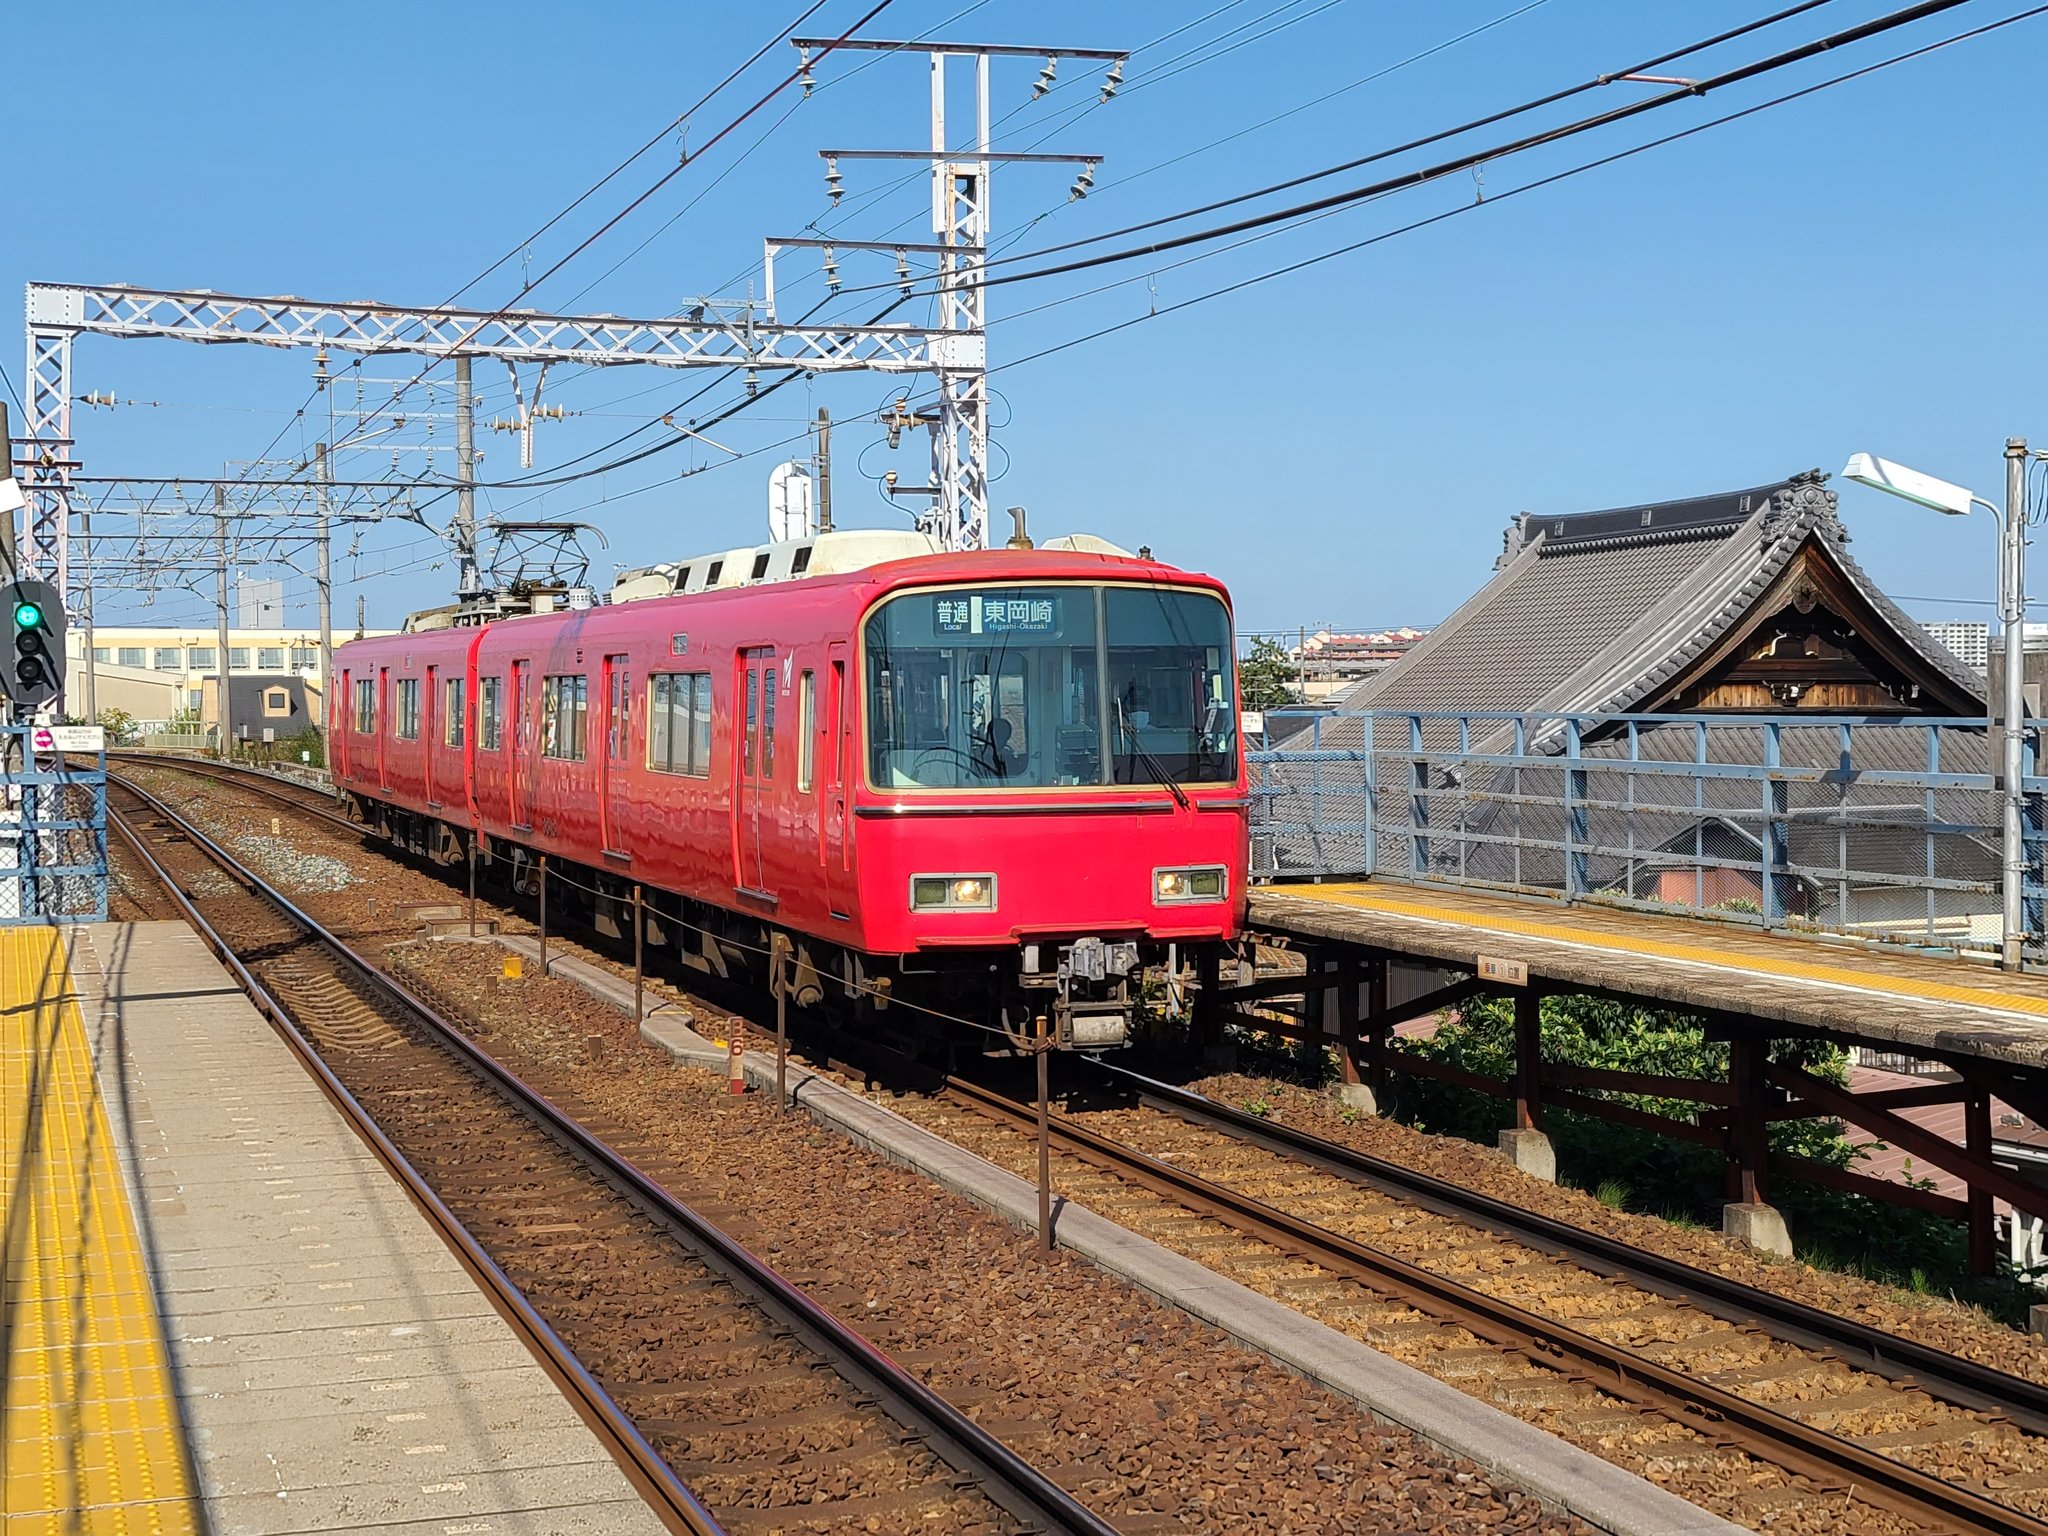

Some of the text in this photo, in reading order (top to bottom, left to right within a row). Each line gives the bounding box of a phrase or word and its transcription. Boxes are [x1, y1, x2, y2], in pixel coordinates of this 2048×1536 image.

[937, 601, 968, 623] 普通
[984, 600, 1052, 623] 東岡崎
[989, 623, 1048, 631] Higashi-Okazaki
[731, 1039, 743, 1056] 6
